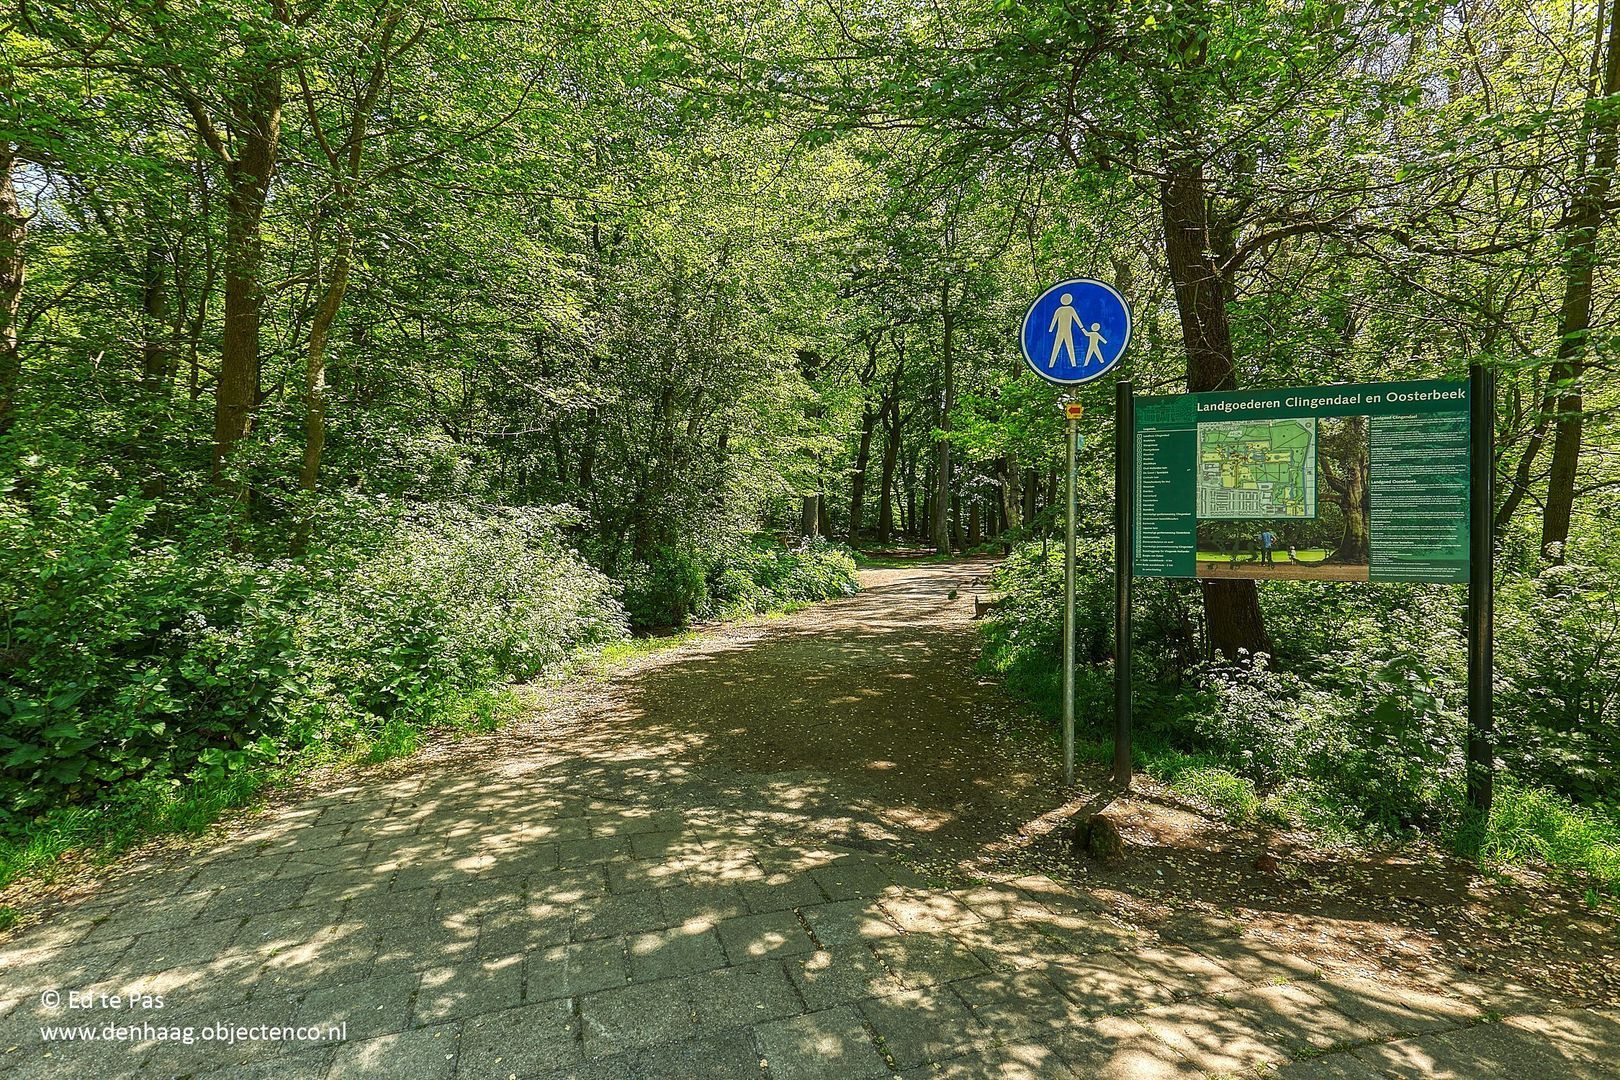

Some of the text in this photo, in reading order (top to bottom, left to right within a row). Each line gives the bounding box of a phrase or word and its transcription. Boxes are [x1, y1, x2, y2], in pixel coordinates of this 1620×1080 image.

[1197, 388, 1466, 413] Landgoederen Clingendael en Oosterbeek
